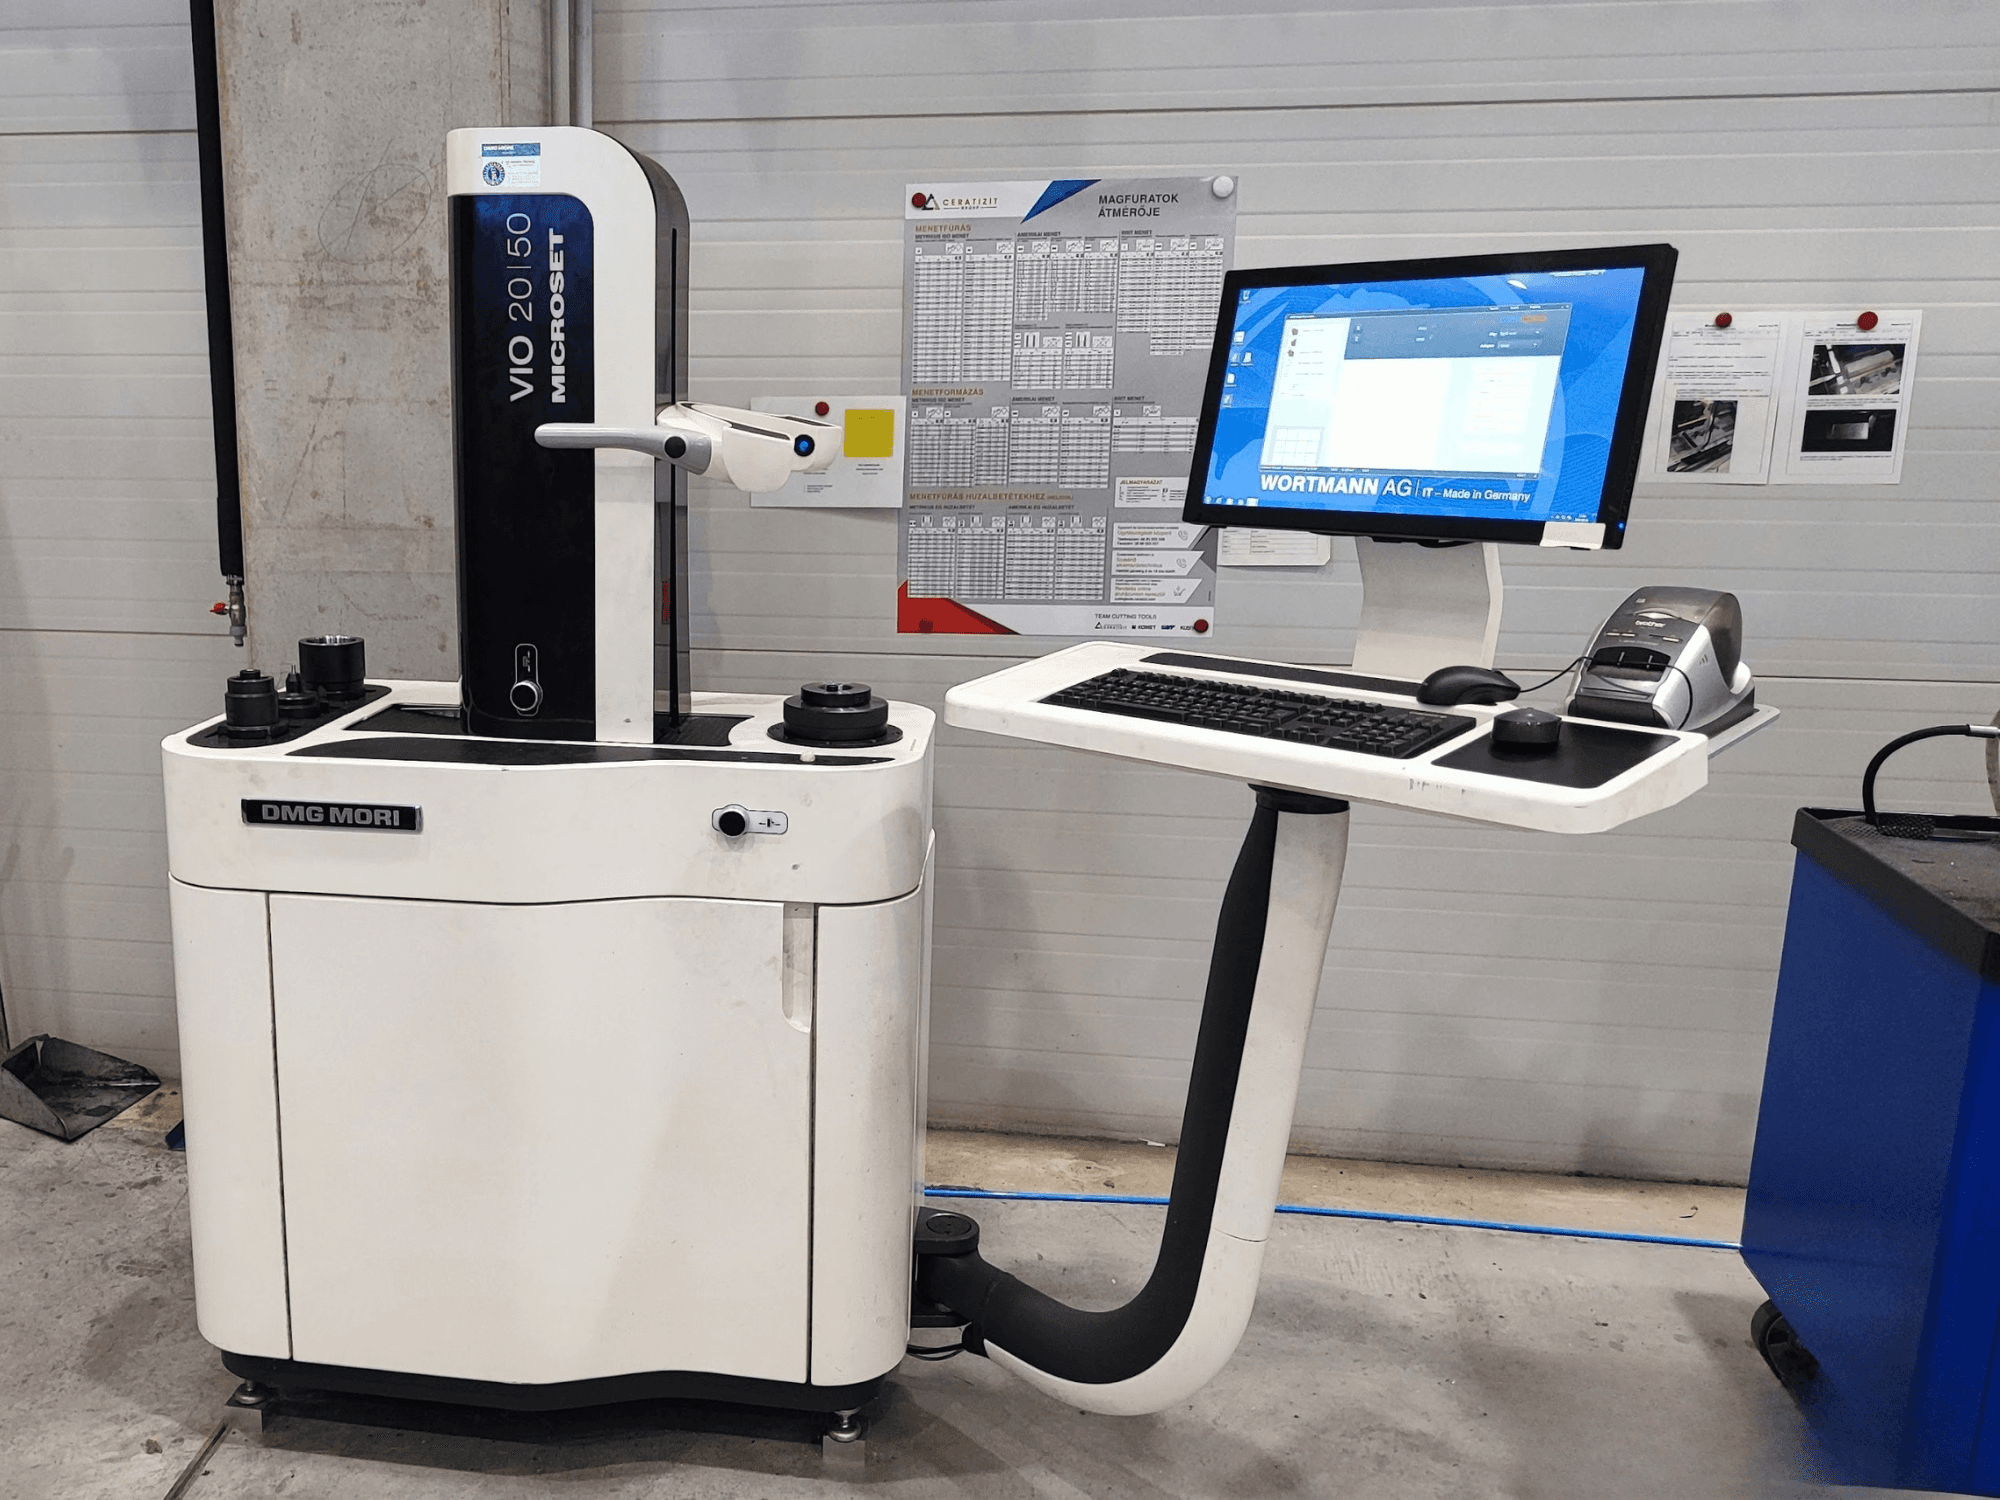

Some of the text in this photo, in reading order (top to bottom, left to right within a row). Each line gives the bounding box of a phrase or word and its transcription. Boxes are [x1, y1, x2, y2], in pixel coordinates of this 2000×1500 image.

[943, 198, 998, 206] CERATIZIT
[1098, 194, 1178, 204] MAGFURATOK
[1098, 206, 1160, 218] ÁTMÉRŐJE
[549, 228, 566, 403] MICROSET
[508, 336, 534, 402] VIO
[1260, 474, 1379, 495] WORTMANN
[1382, 478, 1412, 497] AG
[1422, 487, 1434, 498] IT
[1443, 489, 1470, 500] Made
[1472, 488, 1482, 500] in
[1484, 490, 1531, 503] Germany
[261, 804, 400, 826] DMG MORI
